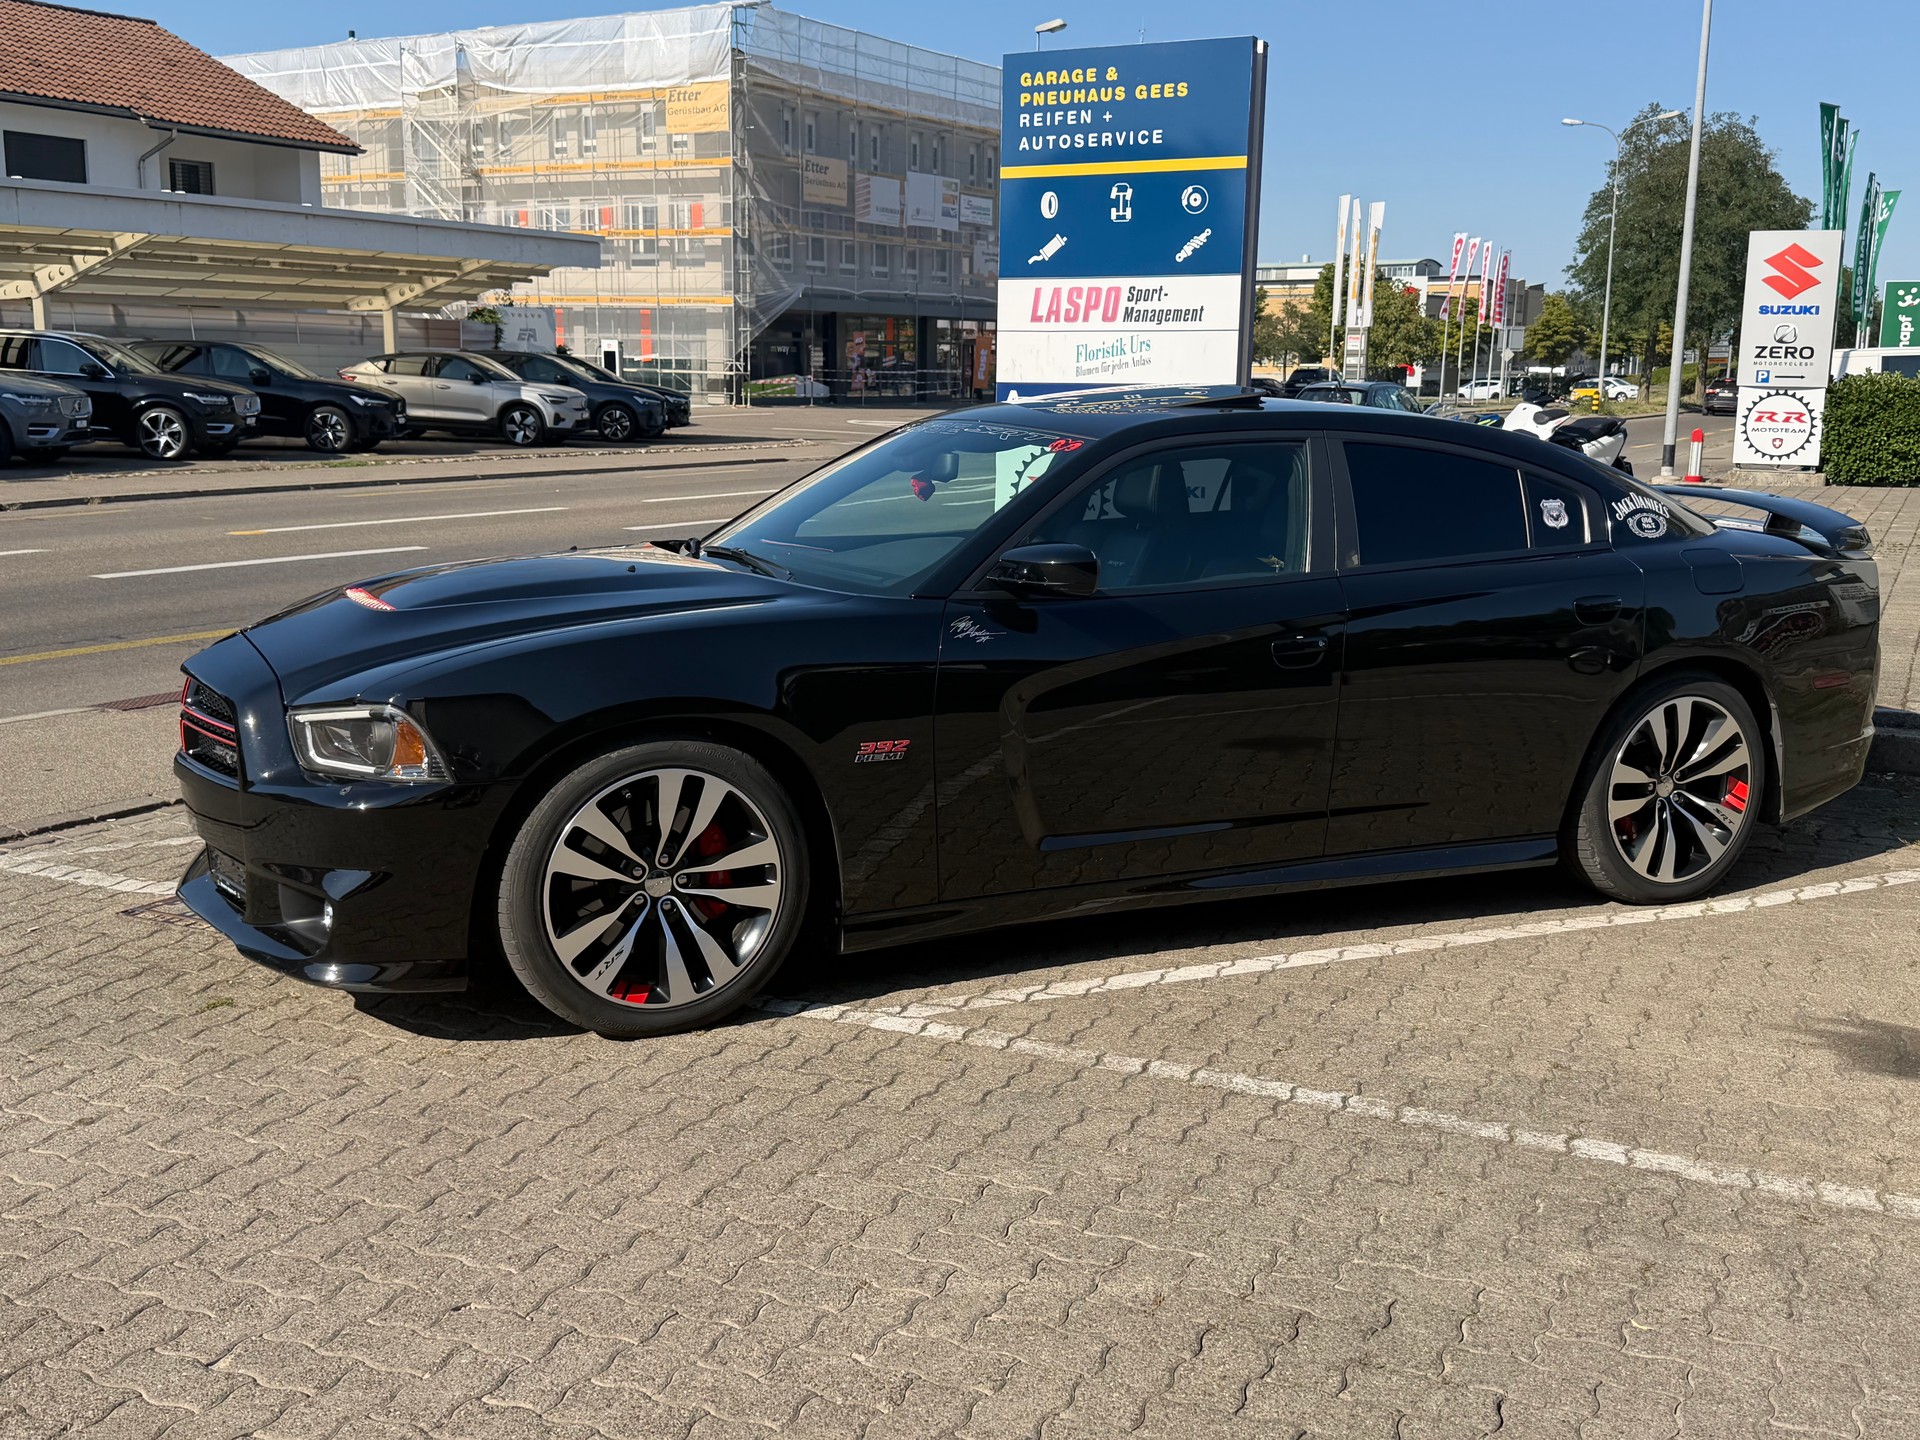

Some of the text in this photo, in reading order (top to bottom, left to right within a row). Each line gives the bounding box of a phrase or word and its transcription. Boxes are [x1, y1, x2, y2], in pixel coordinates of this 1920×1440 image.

[1020, 66, 1118, 87] GARAGE &
[668, 89, 701, 103] Etter
[1020, 82, 1188, 107] PNEUHAUS GEES
[713, 103, 727, 113] AG
[1019, 109, 1113, 128] REIFEN +
[1019, 129, 1163, 151] AUTOSERVICE
[804, 160, 830, 175] Etter
[1030, 285, 1168, 323] LASPO Sport-
[1758, 305, 1820, 315] SUZUKI
[1122, 305, 1205, 325] Management
[1076, 334, 1151, 363] Floristik Urs
[1754, 346, 1814, 360] ZERO
[1075, 366, 1100, 377] Blumen
[1111, 358, 1129, 375] jeden
[1131, 355, 1152, 368] Anlass
[857, 740, 910, 755] 392
[854, 752, 905, 763] HEMI
[1712, 807, 1736, 826] SRT
[595, 945, 625, 981] SRT
